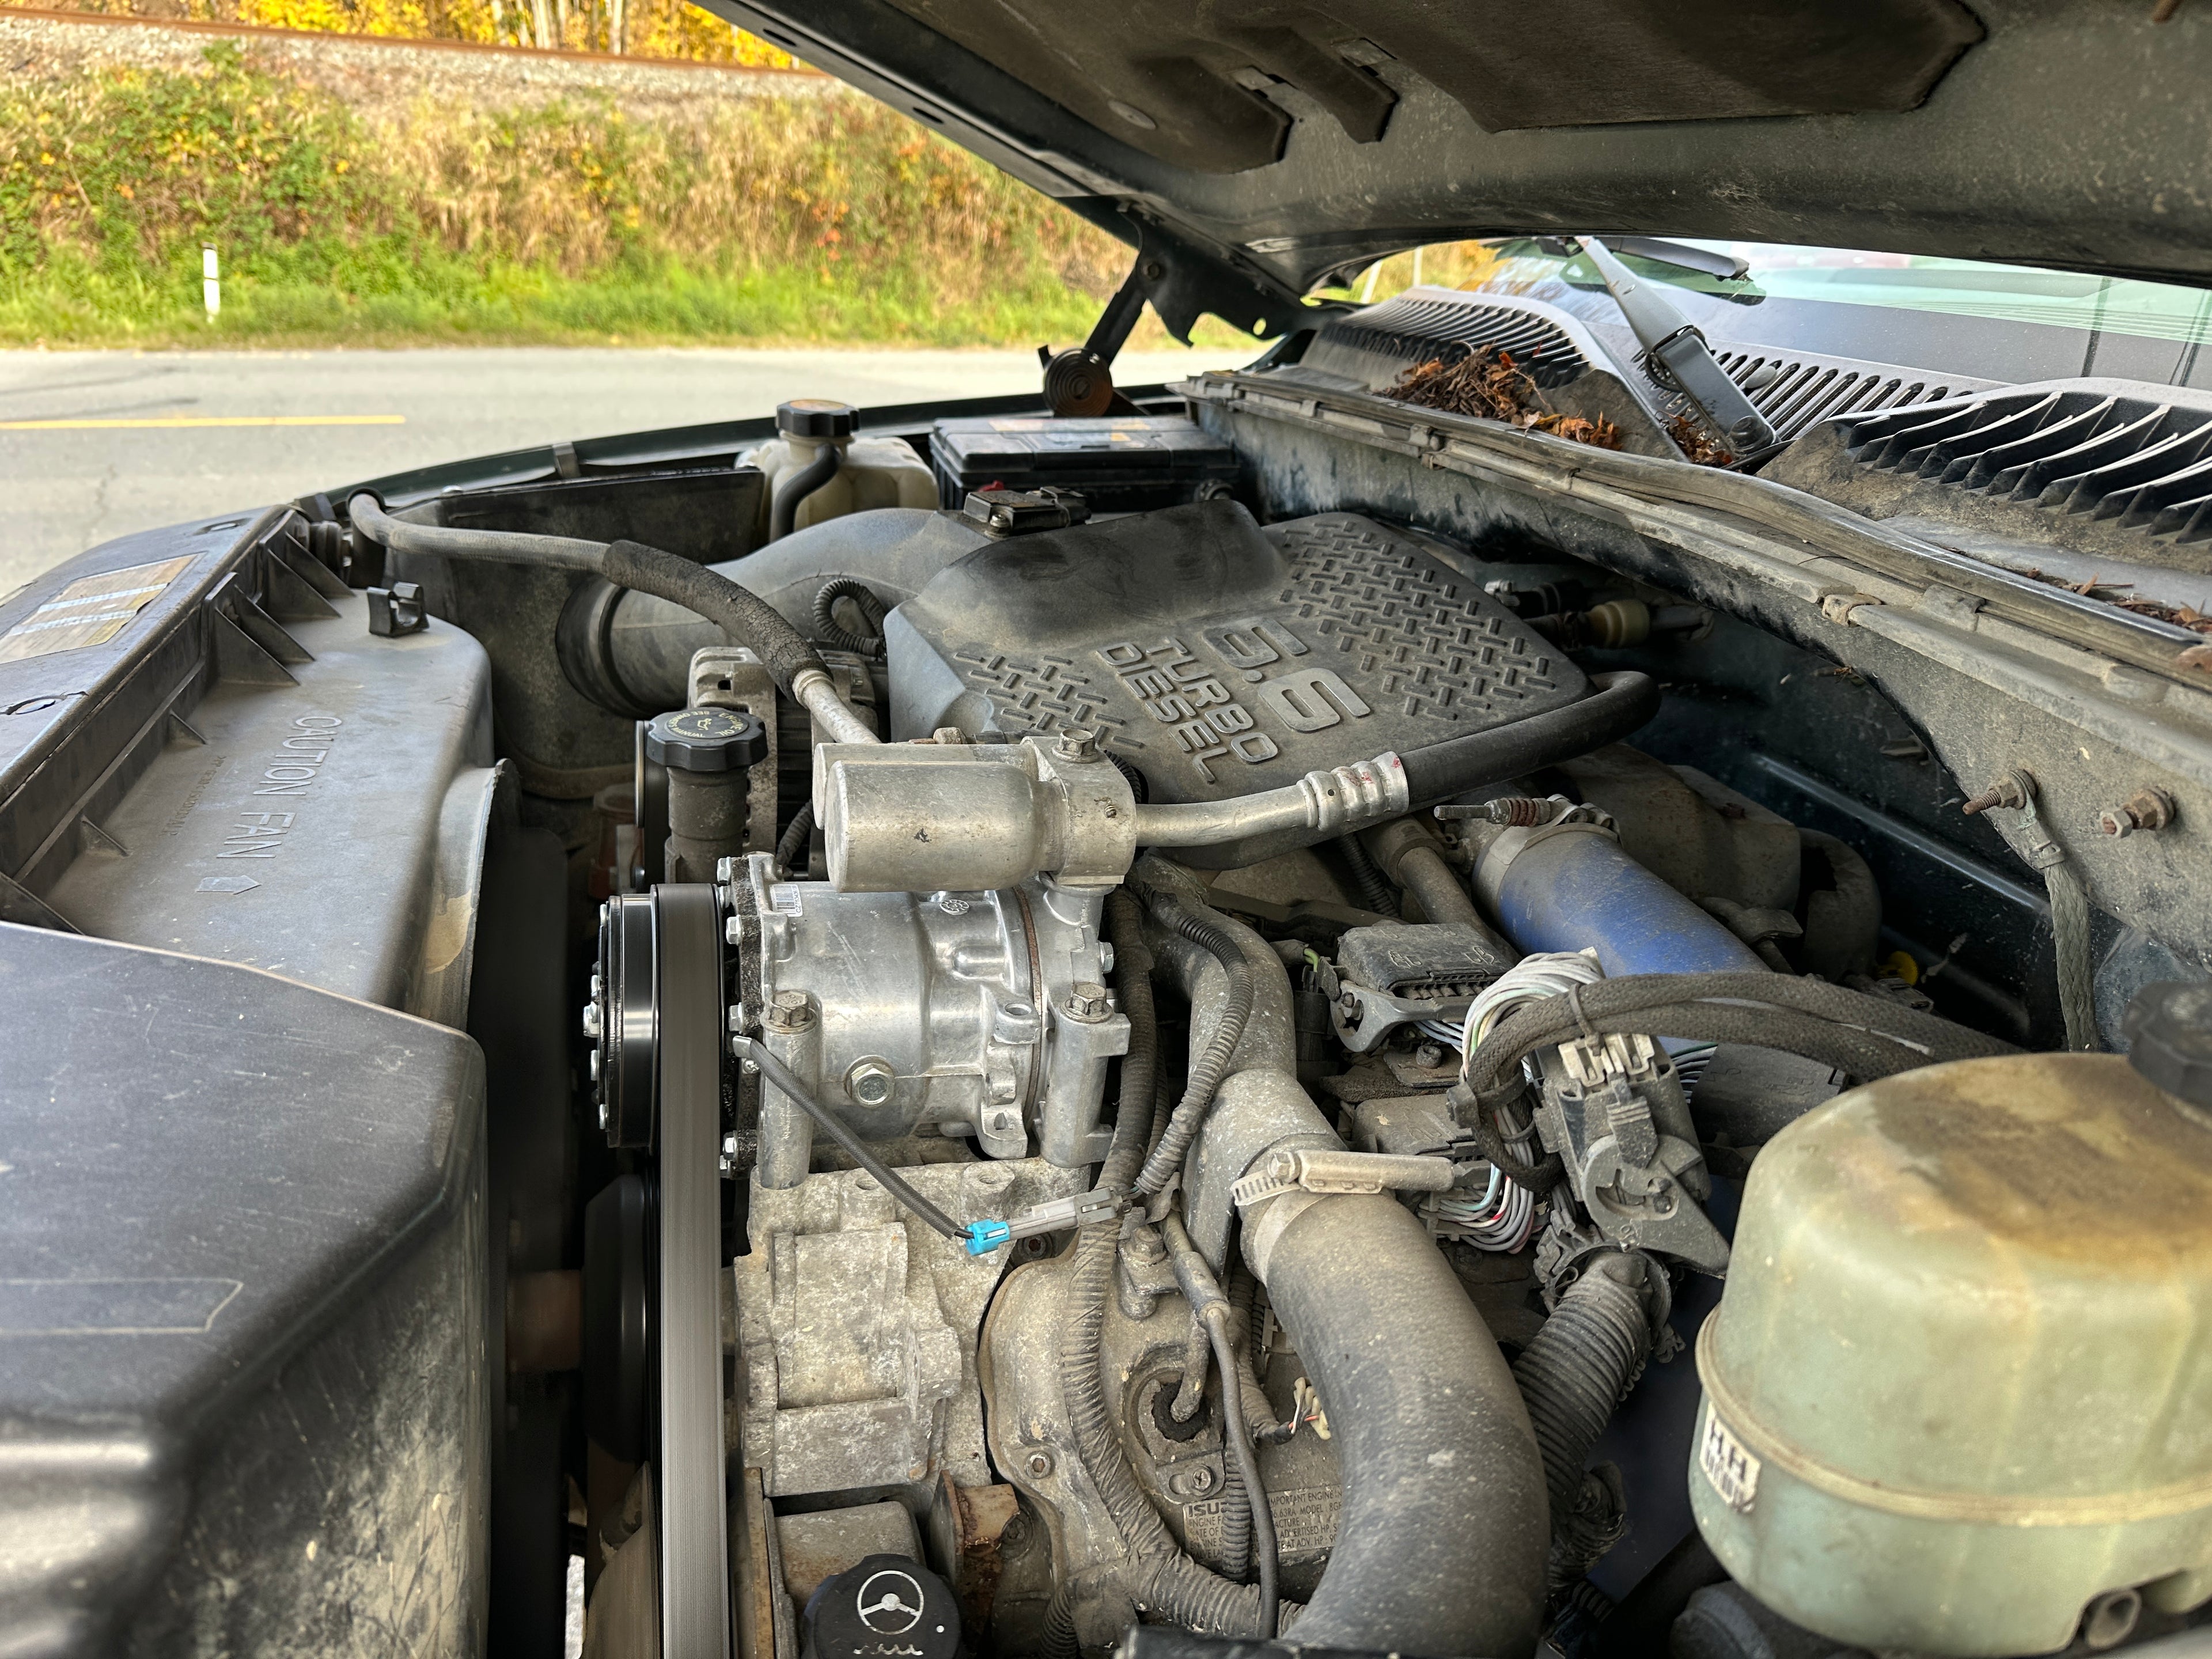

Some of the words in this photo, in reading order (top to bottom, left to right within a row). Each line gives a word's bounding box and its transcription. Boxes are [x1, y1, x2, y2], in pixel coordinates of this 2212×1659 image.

[1202, 616, 1371, 733] 6.6
[1094, 642, 1228, 784] DIESEL
[1146, 636, 1278, 765] TURBO
[671, 727, 706, 737] MANUAL
[718, 712, 744, 730] ENGINE
[253, 716, 342, 796] CAUTION
[217, 812, 297, 858] FAN
[1308, 1489, 1334, 1502] ENGINE
[1189, 1516, 1215, 1528] ENGINE
[1300, 1503, 1324, 1514] MODEL
[1209, 1527, 1219, 1537] OF
[1280, 1525, 1319, 1539] ADERTISED
